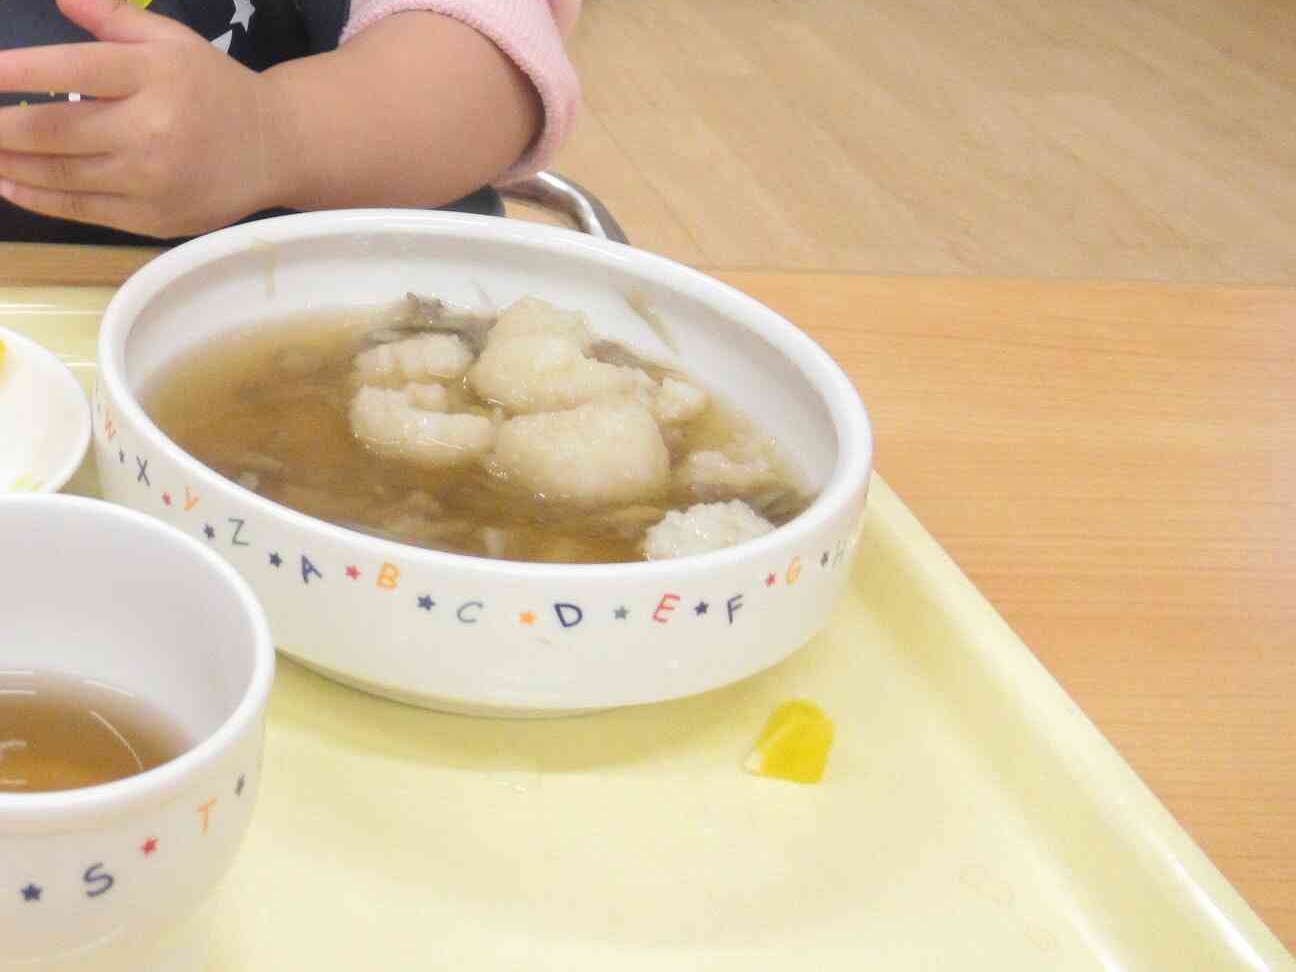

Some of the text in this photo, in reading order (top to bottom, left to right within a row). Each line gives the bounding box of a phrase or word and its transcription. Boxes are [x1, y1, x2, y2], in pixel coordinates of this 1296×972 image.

[135, 455, 151, 487] X
[227, 517, 250, 546] Z
[301, 555, 323, 583] A
[377, 564, 399, 590] B
[456, 601, 484, 625] C
[554, 603, 583, 627] D
[652, 594, 680, 623] E
[726, 595, 744, 624] F
[83, 862, 114, 897] S
[196, 797, 216, 834] T
